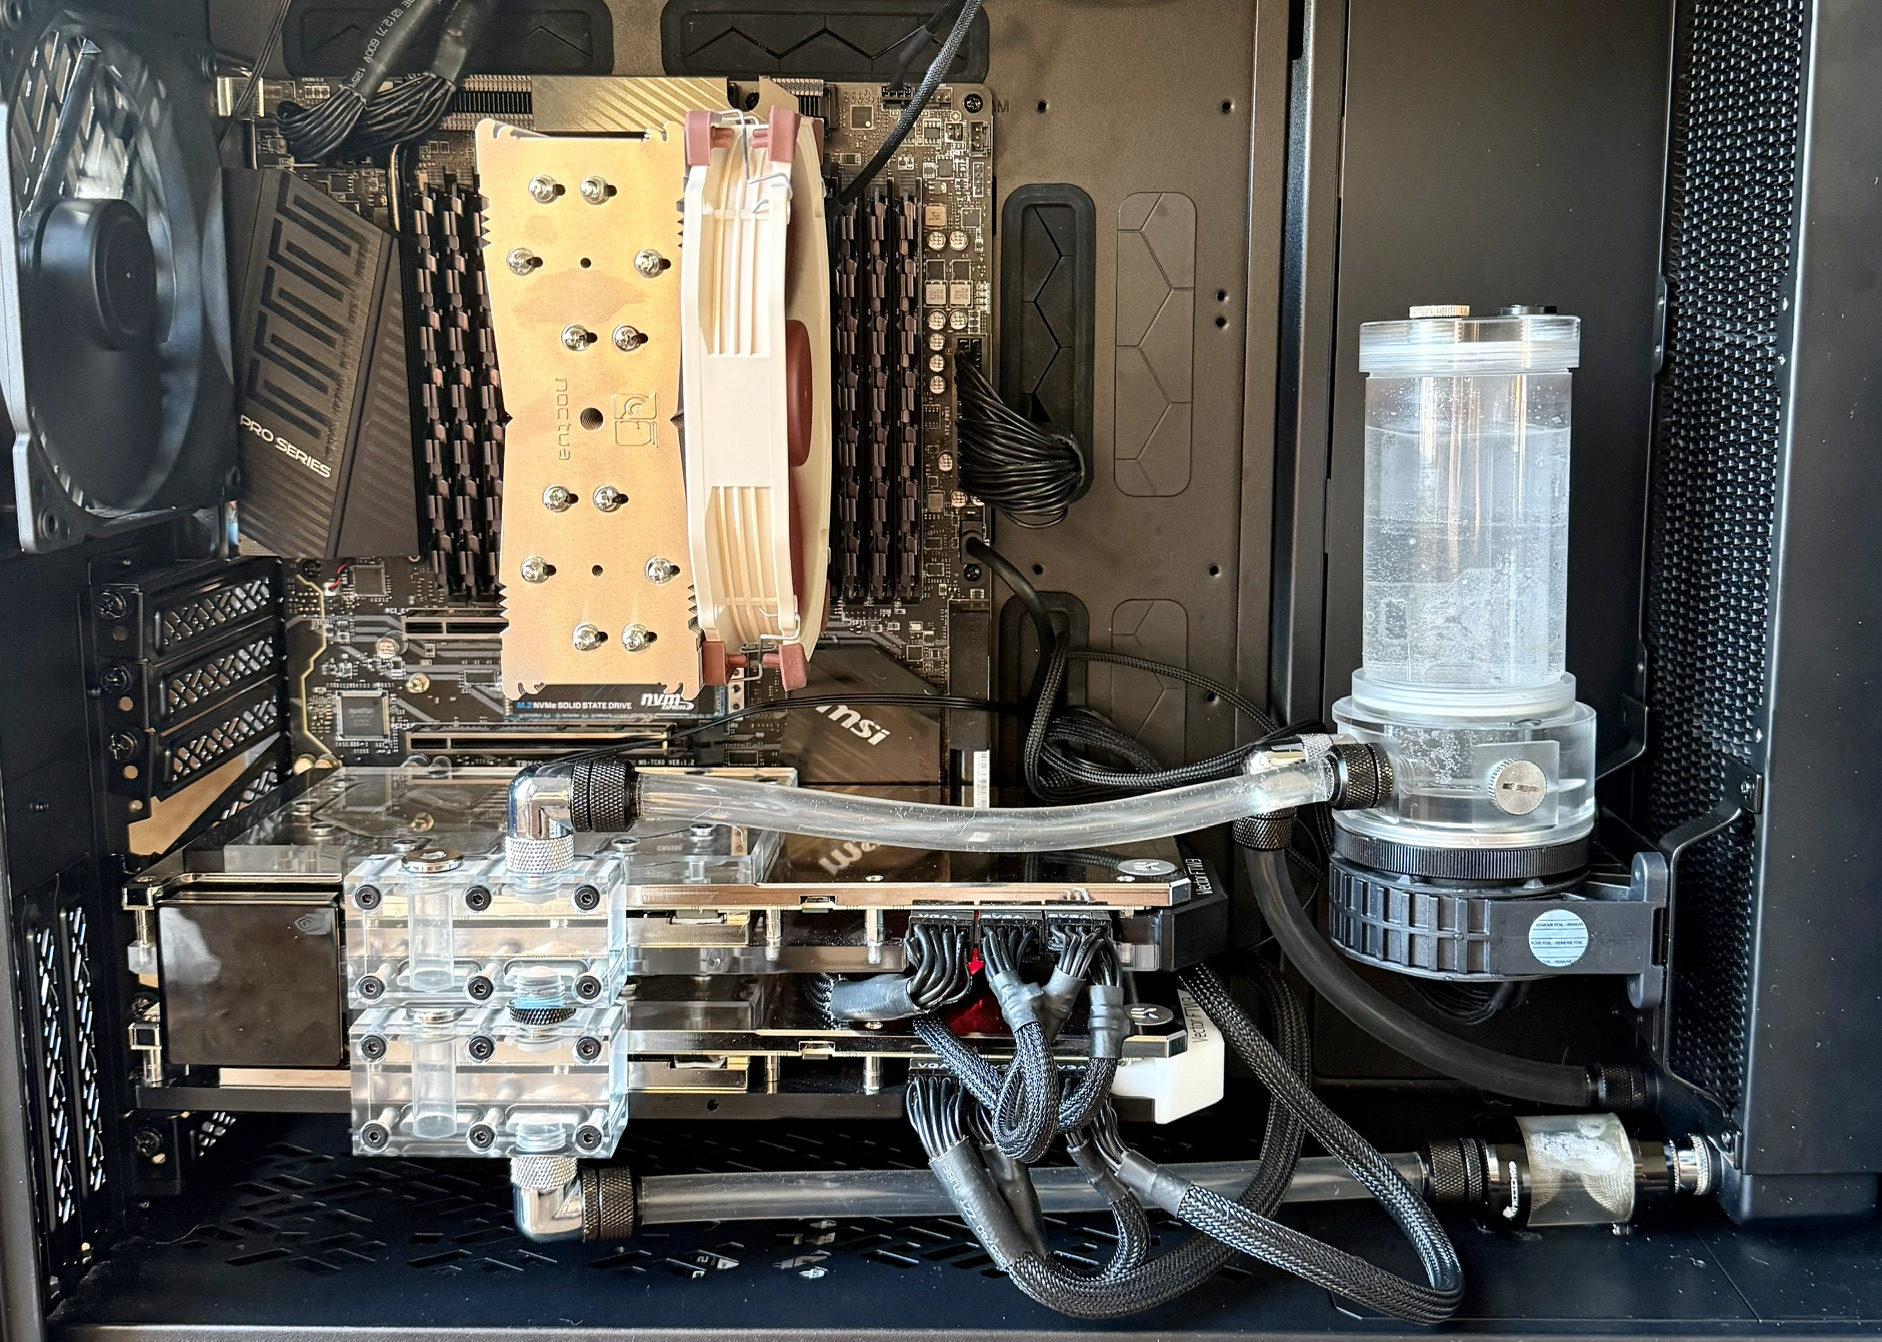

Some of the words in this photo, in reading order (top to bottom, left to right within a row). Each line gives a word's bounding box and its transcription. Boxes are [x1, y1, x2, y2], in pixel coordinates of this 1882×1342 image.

[363, 38, 380, 63] 600V
[555, 378, 571, 461] noctua
[240, 414, 274, 442] PRO
[275, 437, 332, 478] SERIES
[516, 701, 532, 709] M.2
[533, 701, 557, 709] NVMe
[557, 701, 581, 709] SOLID
[582, 701, 607, 709] STATE
[608, 701, 632, 709] DRIVE
[815, 704, 891, 746] msi
[1189, 1019, 1208, 1044] Vector
[942, 1164, 962, 1195] TUBE
